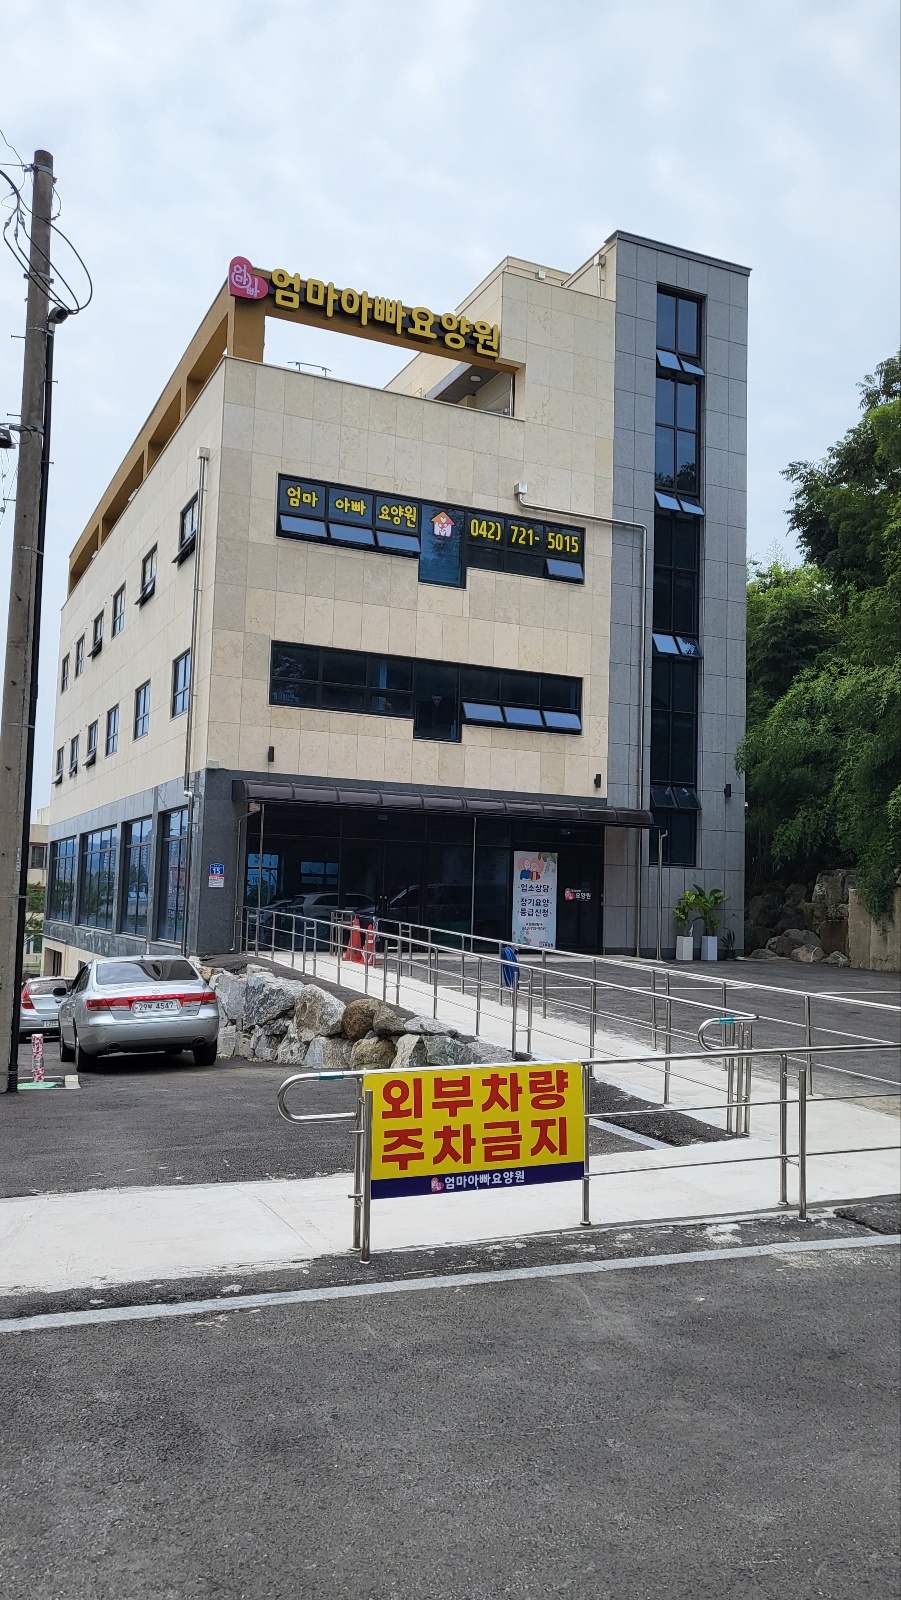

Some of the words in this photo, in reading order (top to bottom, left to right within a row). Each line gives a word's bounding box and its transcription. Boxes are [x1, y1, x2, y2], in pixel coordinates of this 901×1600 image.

[271, 268, 500, 358] 엄마아빠요양원
[286, 485, 319, 508] 엄마
[335, 496, 367, 516] 아빠
[378, 503, 418, 528] 요양원
[470, 518, 502, 541] 042)
[510, 525, 541, 546] 721-
[547, 531, 580, 554] 5015
[520, 898, 550, 907] 장기요양
[381, 1069, 569, 1119] 외부차량
[381, 1116, 568, 1171] 주차금지
[444, 1170, 525, 1189] 엄마아빠요양원
